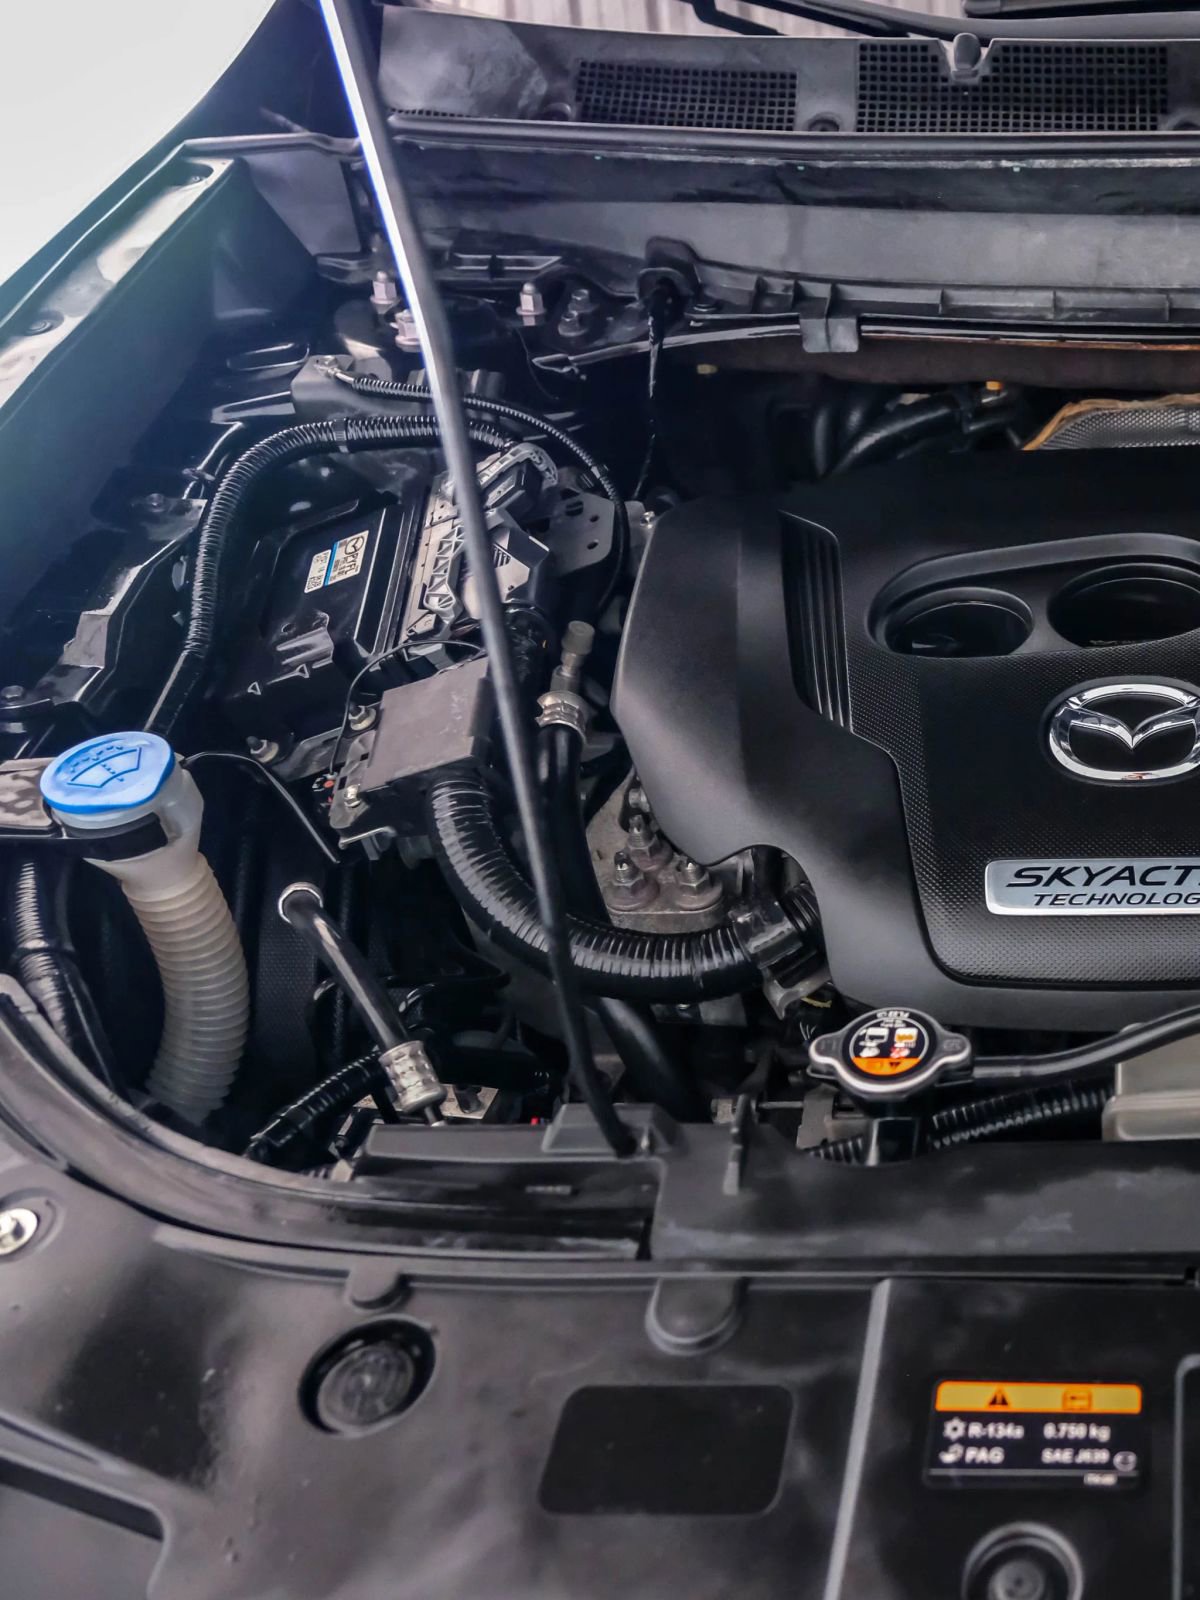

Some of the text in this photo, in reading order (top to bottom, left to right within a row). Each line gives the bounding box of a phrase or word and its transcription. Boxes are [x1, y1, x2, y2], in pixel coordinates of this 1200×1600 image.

[967, 1422, 1024, 1439] R-134a
[1089, 1423, 1111, 1442] kg
[964, 1447, 1005, 1464] PAG
[1041, 1448, 1072, 1464] SAE
